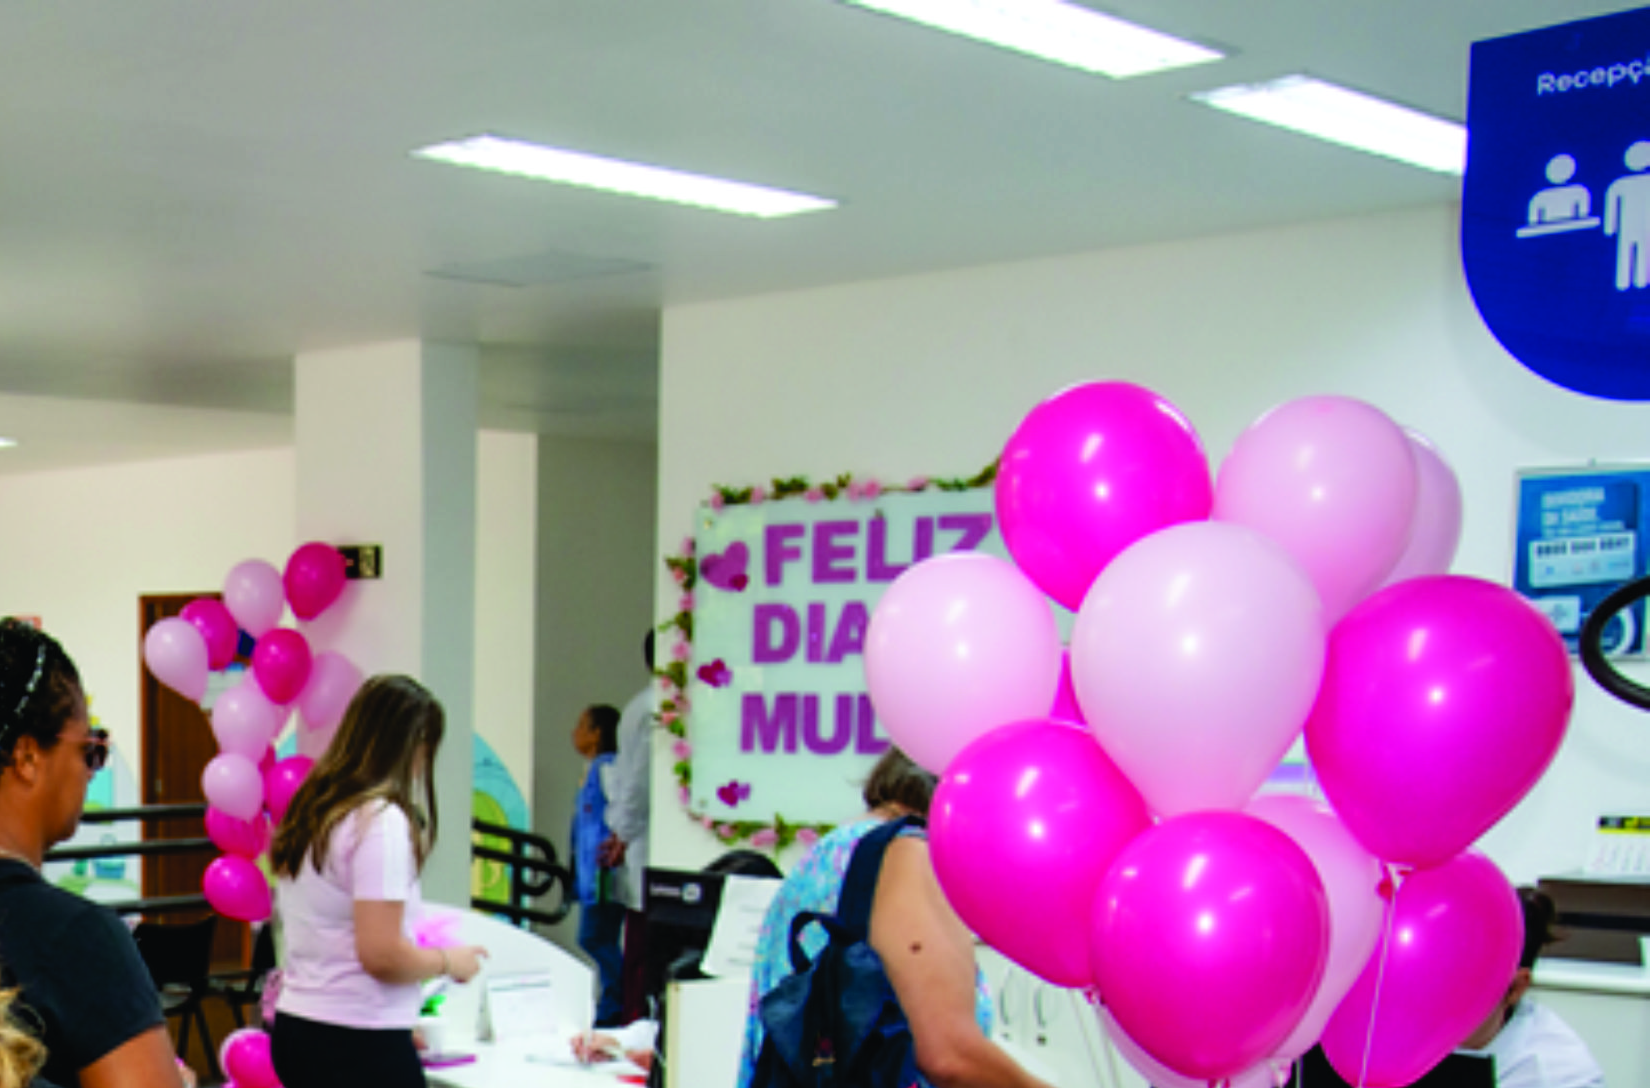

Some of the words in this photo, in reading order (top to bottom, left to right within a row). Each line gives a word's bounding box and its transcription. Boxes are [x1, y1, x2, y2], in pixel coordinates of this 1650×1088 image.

[1536, 50, 1650, 96] Recepç
[764, 512, 994, 587] FELIZ
[751, 600, 869, 665] DIA
[738, 692, 893, 755] MUL
